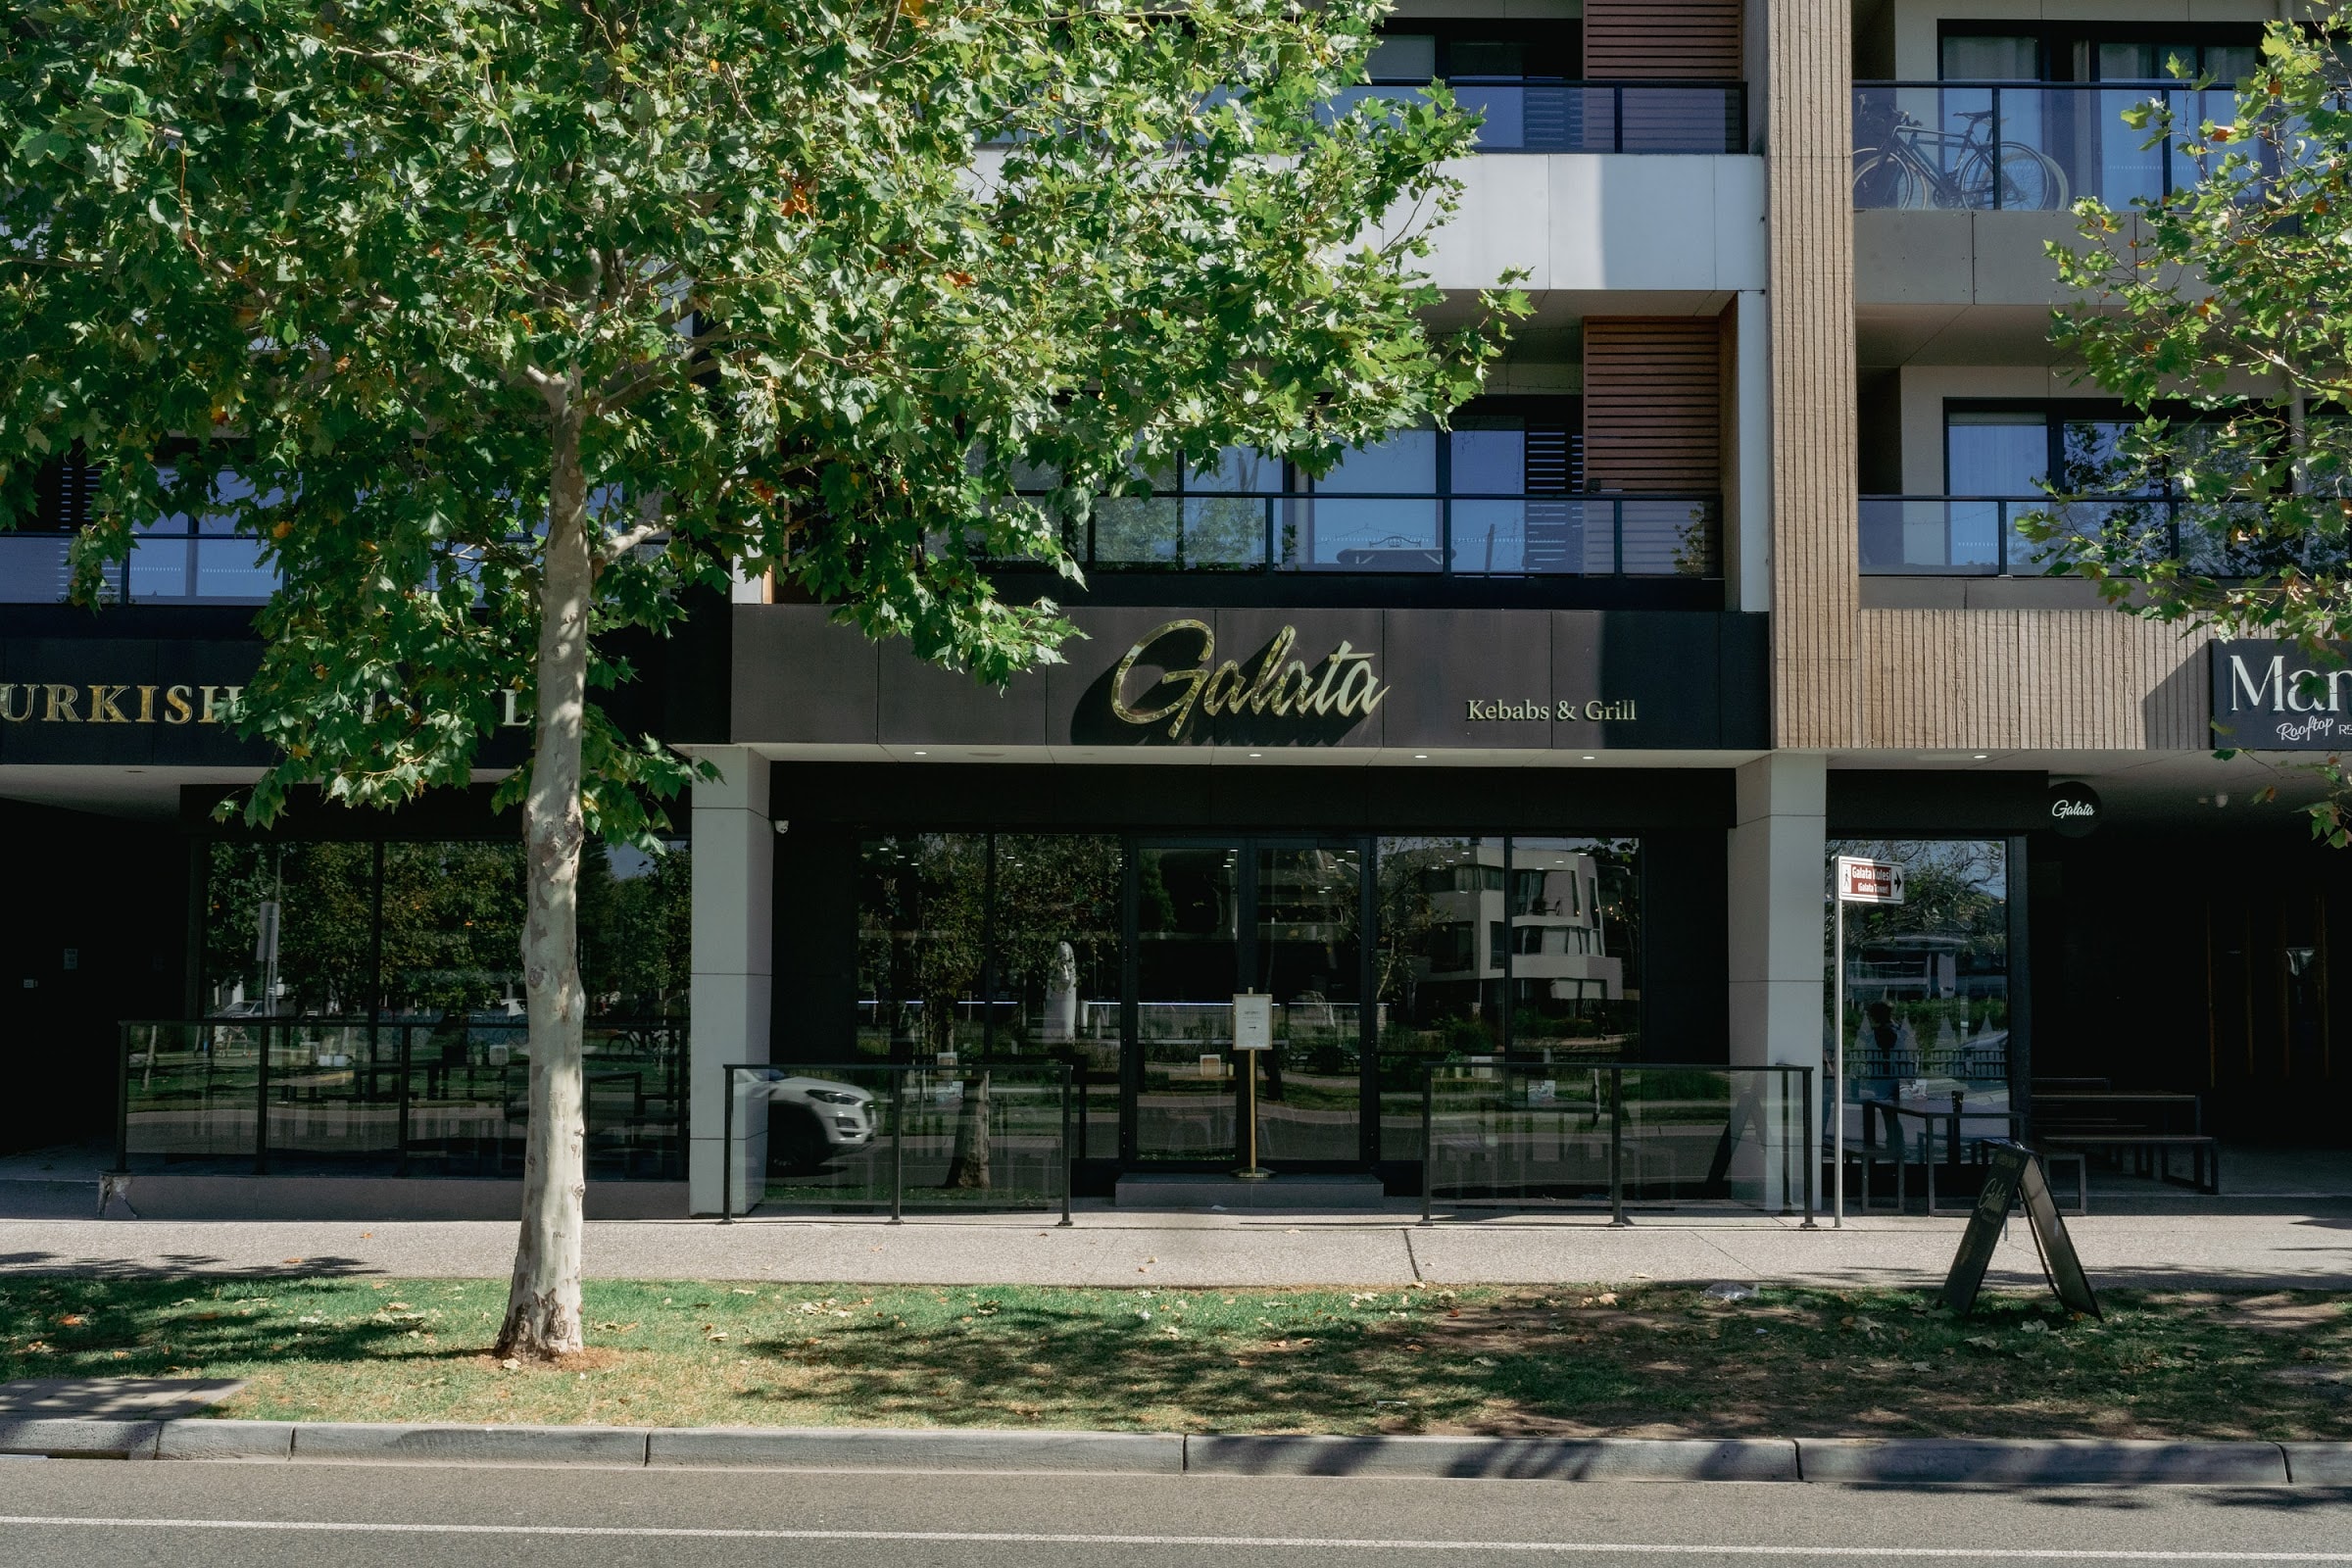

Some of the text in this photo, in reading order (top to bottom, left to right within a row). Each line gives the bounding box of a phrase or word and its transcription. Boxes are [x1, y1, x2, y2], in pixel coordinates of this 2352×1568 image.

[1111, 618, 1391, 739] Galata
[1467, 699, 1637, 720] Kebabs & Grill
[2276, 714, 2334, 742] Rooftop
[2051, 799, 2096, 819] Galata
[1852, 865, 1872, 880] Galata
